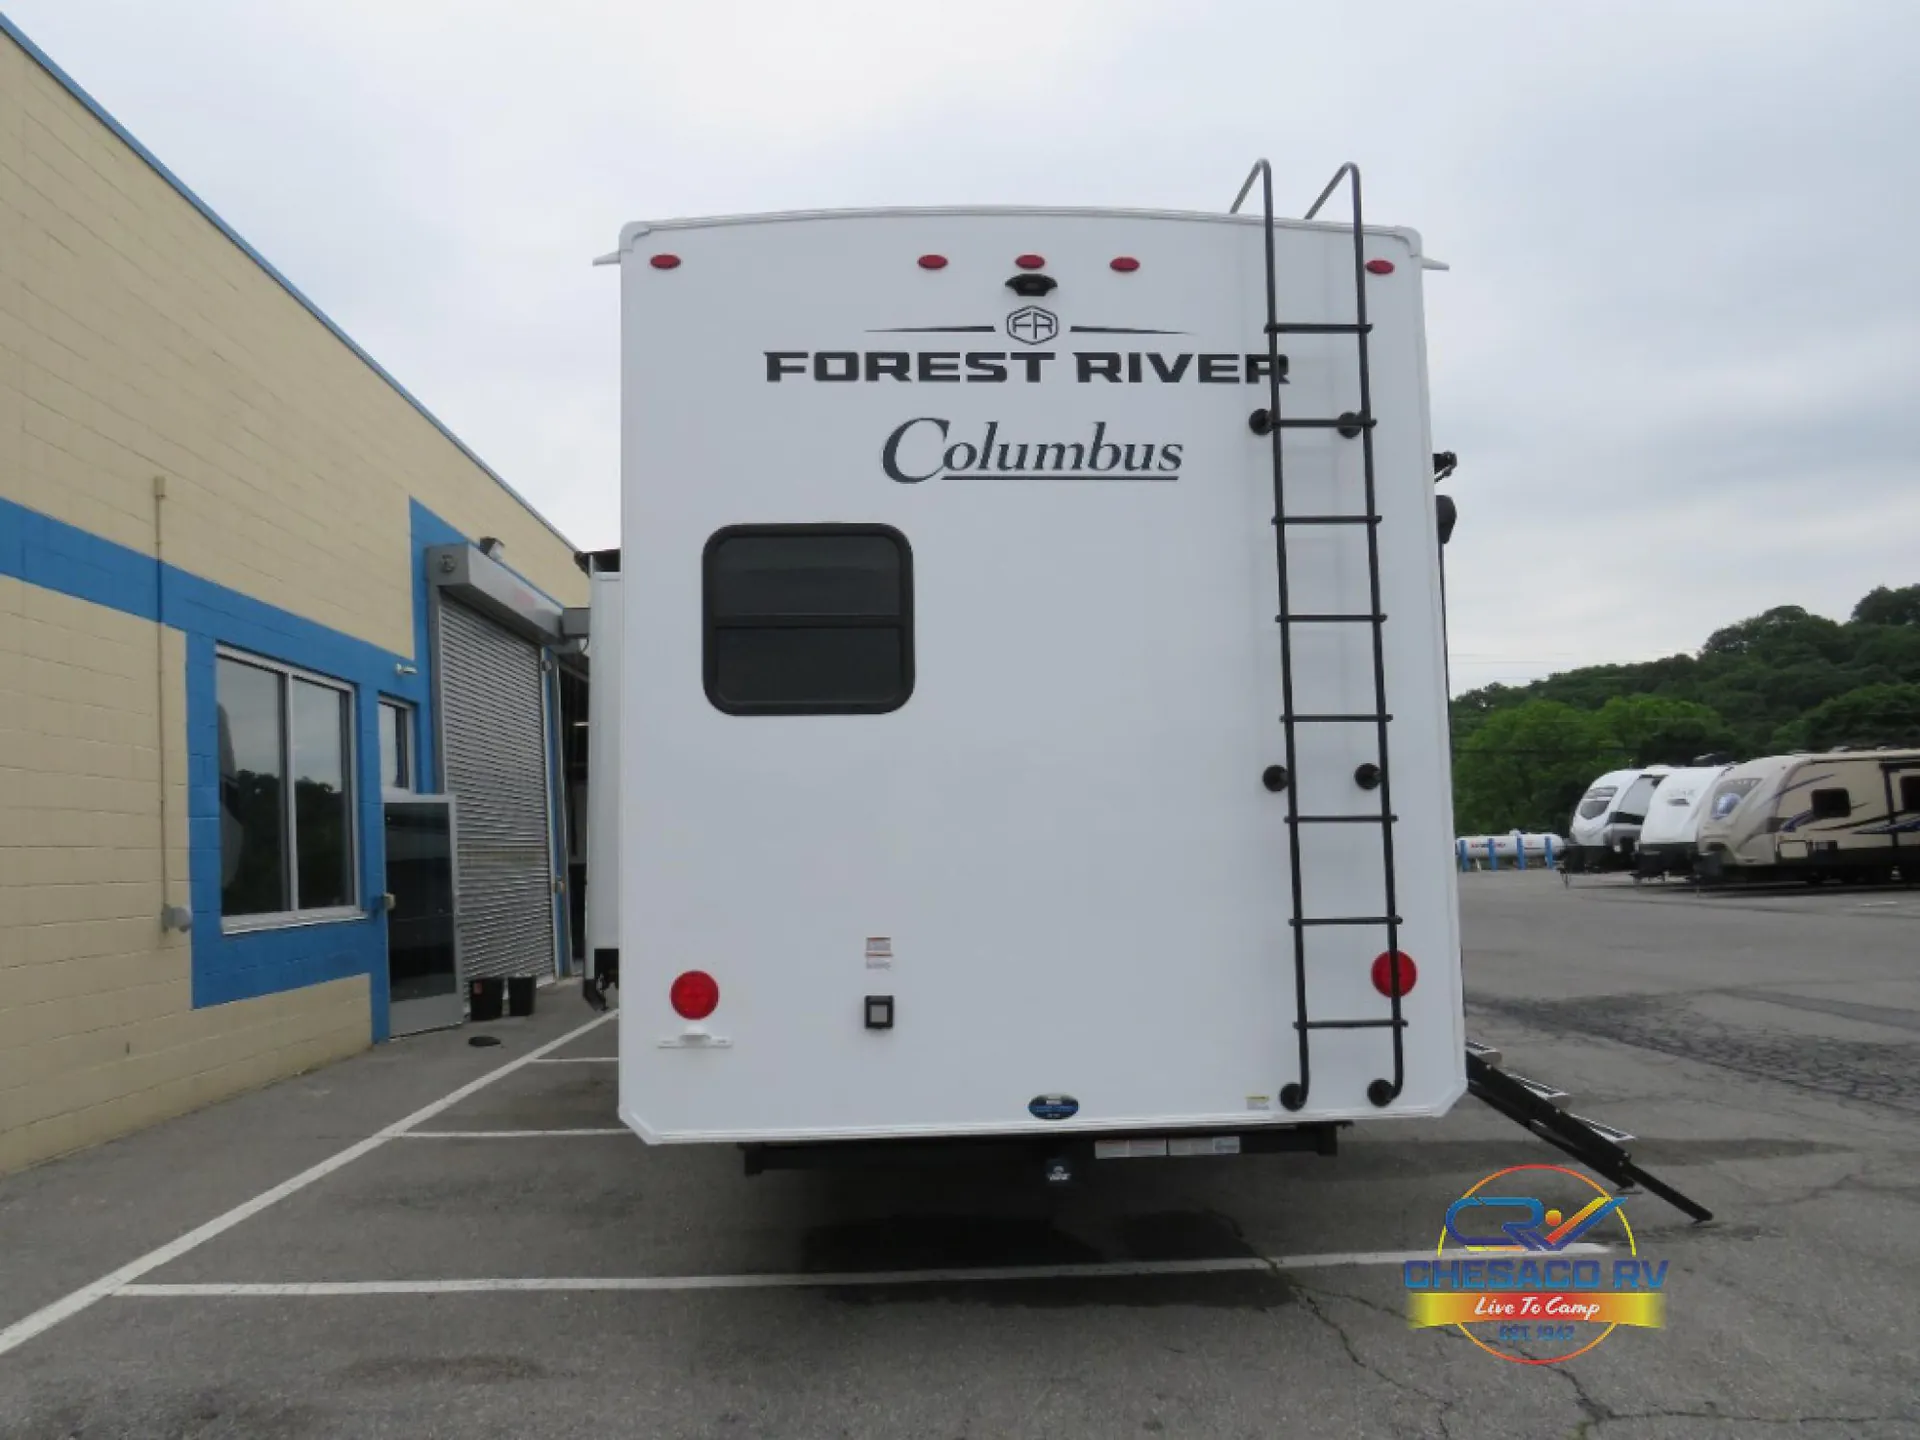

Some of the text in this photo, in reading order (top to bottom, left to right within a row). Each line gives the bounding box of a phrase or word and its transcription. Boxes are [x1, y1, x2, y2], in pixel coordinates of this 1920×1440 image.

[764, 351, 1291, 385] FOREST RIVER
[882, 416, 1184, 484] Columbus
